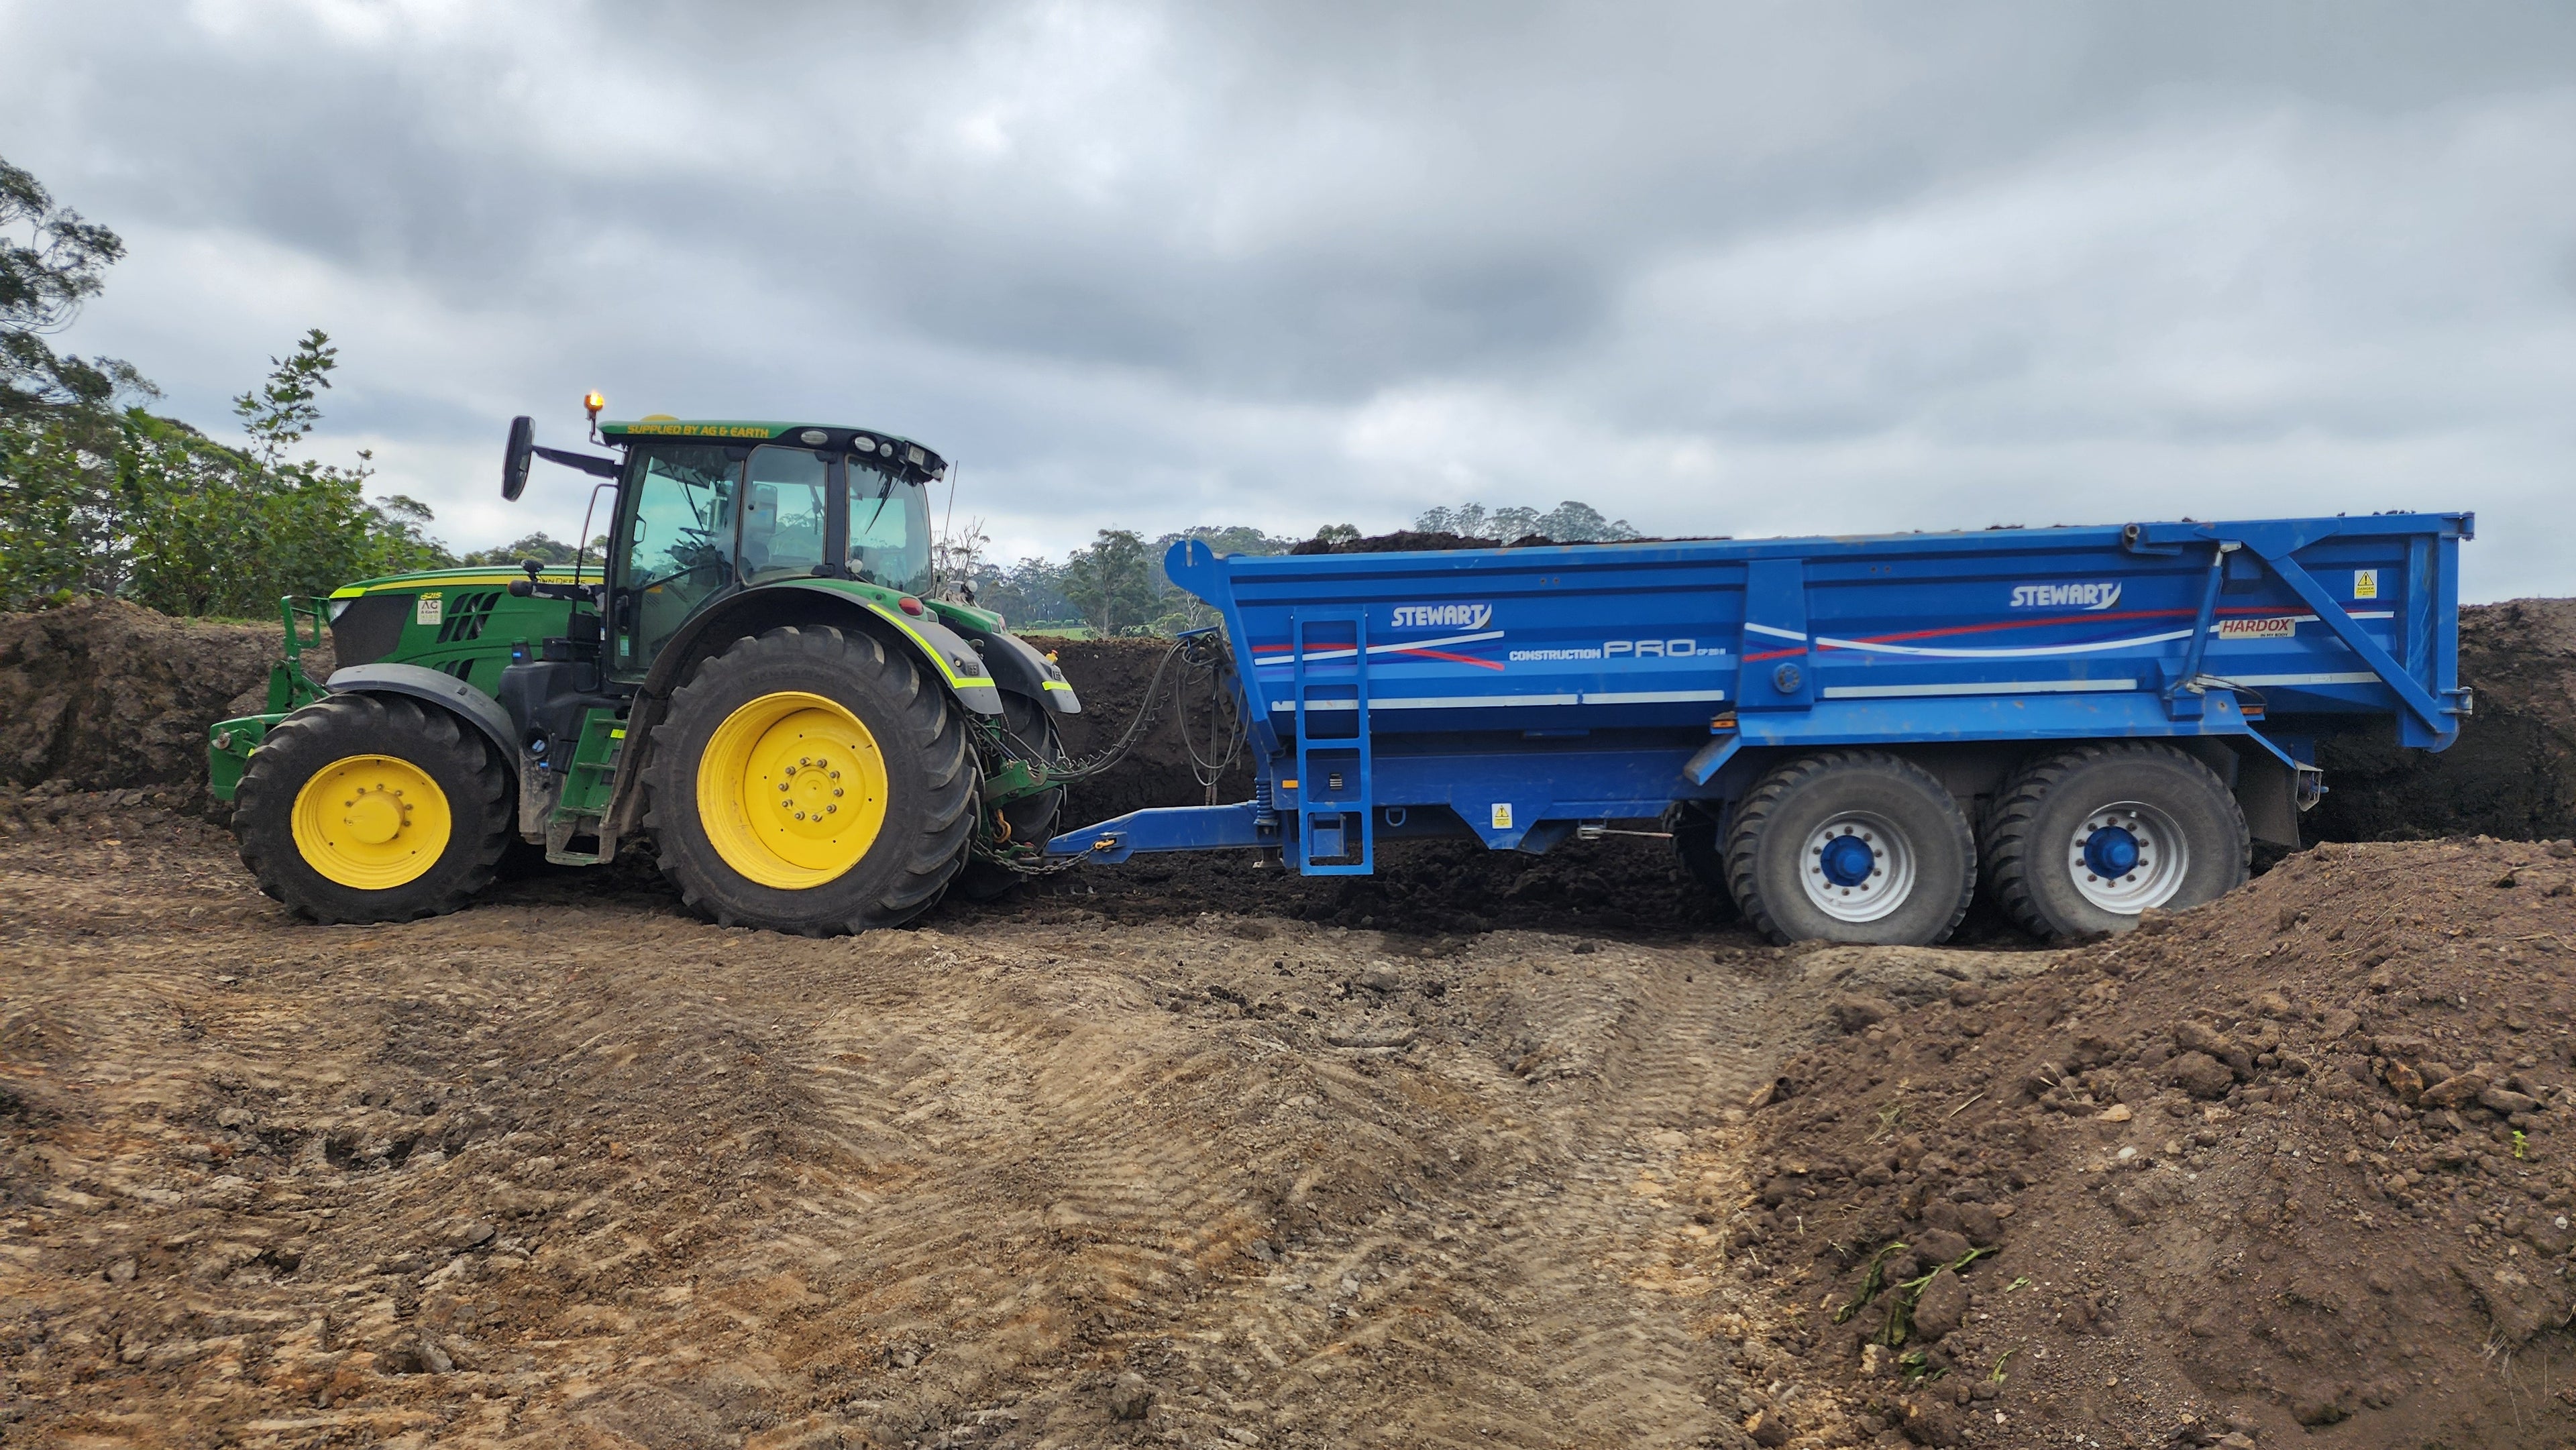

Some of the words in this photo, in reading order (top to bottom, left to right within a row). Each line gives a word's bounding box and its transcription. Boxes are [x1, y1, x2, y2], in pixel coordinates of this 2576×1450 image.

[627, 425, 681, 435] SUPPLIED
[683, 425, 698, 435] BY
[700, 426, 717, 435] AG
[719, 427, 728, 436] &
[730, 427, 769, 438] EARTH
[421, 601, 438, 610] AG
[2010, 581, 2121, 610] STEWART
[1391, 604, 1492, 630] STEWART
[1509, 649, 1601, 661] CONSTRUCTION
[1603, 639, 1696, 659] PRO
